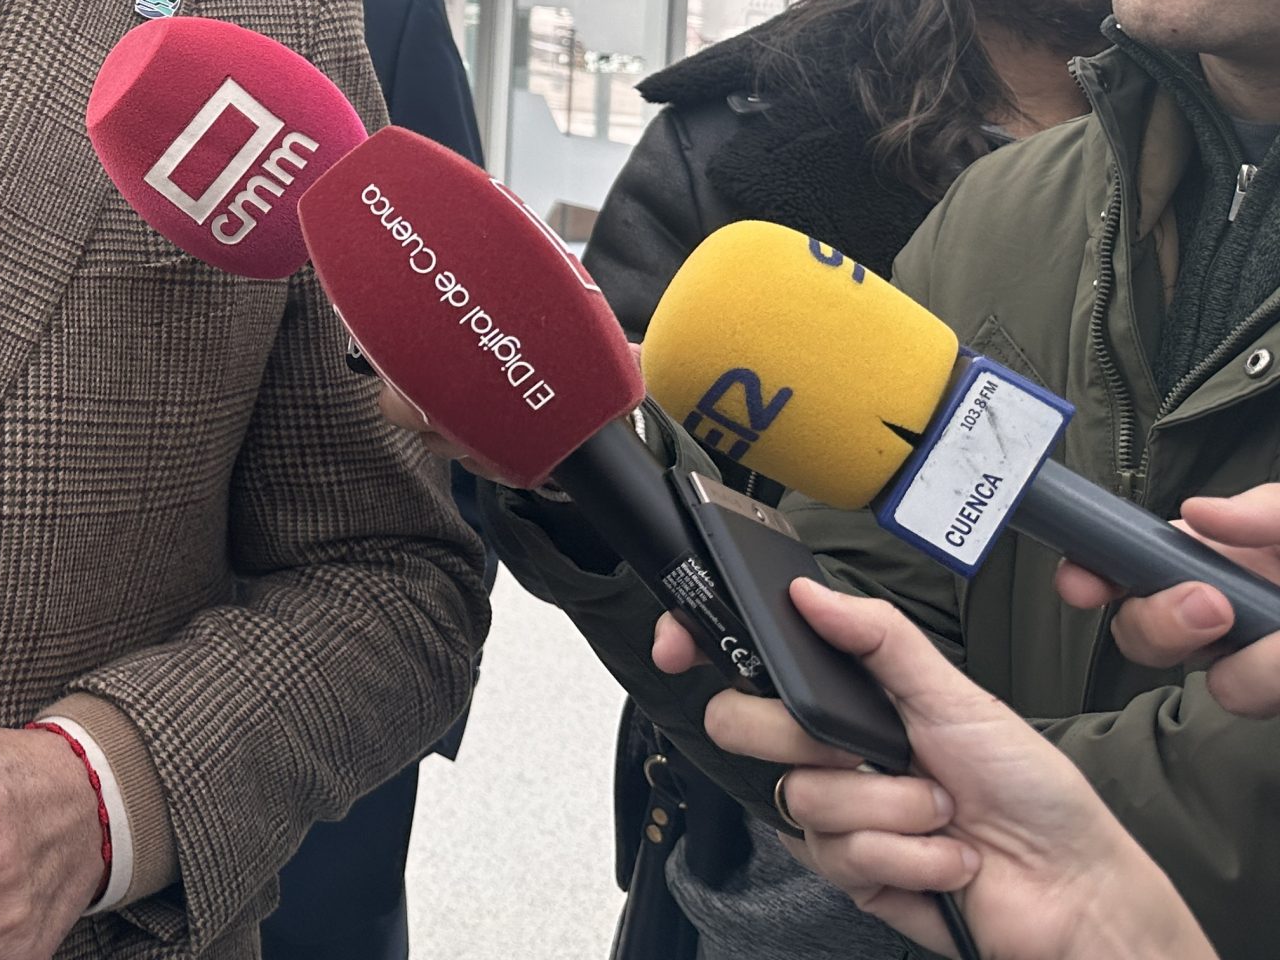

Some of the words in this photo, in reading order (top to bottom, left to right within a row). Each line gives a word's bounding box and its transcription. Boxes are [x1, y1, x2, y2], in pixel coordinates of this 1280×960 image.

[361, 183, 437, 274] Cuenca
[434, 271, 470, 307] de
[458, 305, 536, 388] Digital
[522, 380, 556, 410] El
[945, 473, 1004, 548] CUENCA
